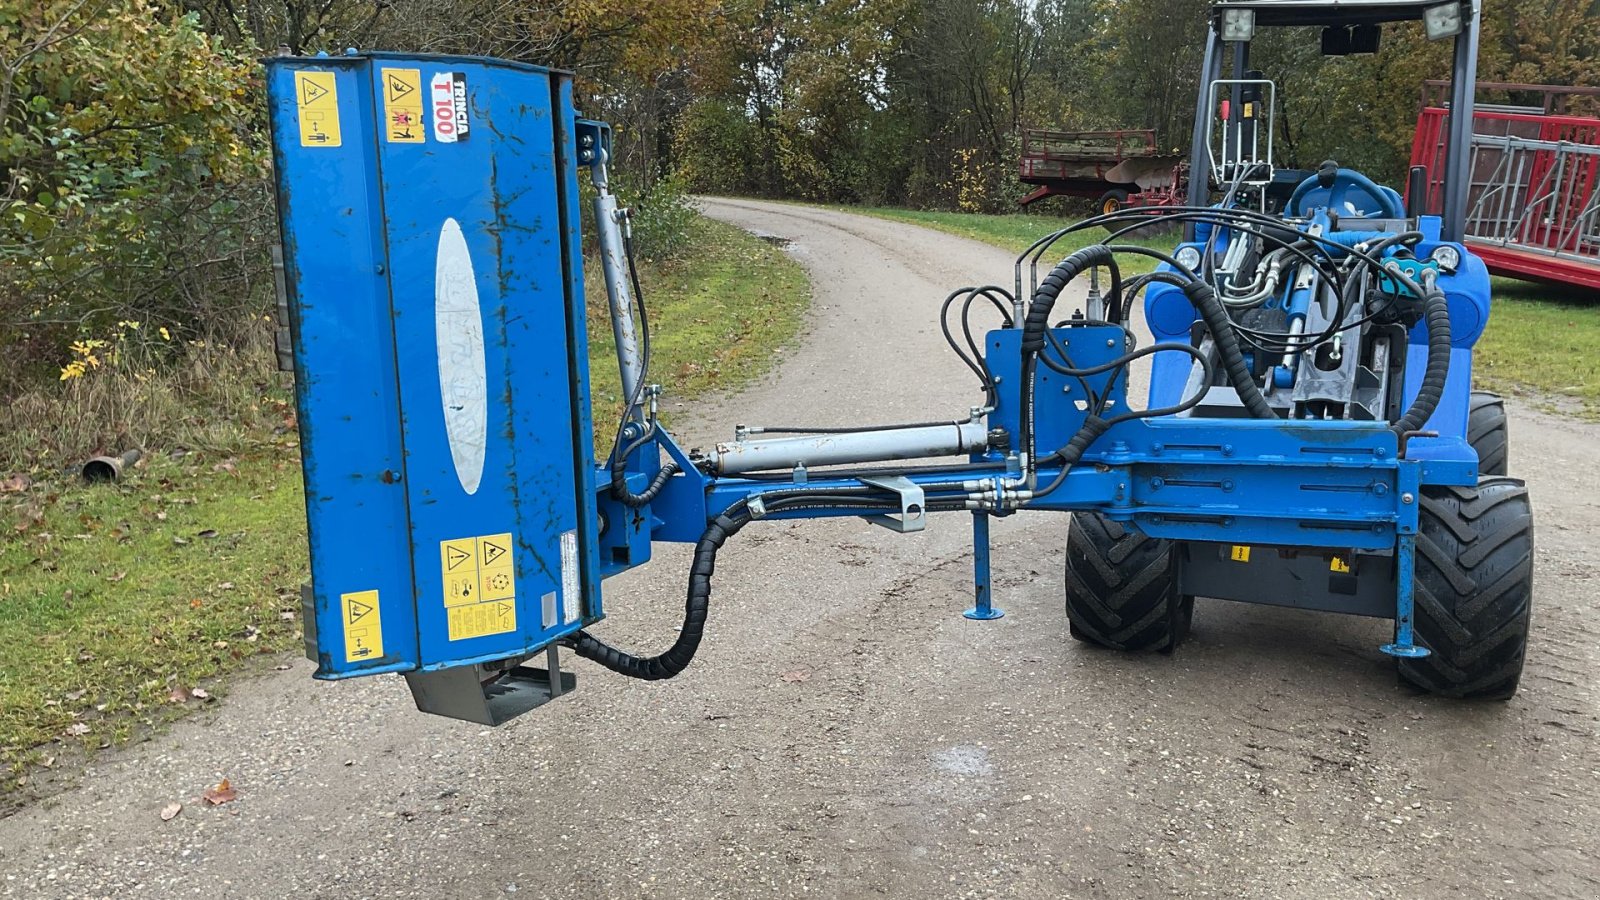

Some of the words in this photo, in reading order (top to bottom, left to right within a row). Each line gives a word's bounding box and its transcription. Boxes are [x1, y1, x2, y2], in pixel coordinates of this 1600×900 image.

[434, 81, 451, 94] T
[436, 99, 455, 134] 100
[453, 81, 469, 134] TRINCIA
